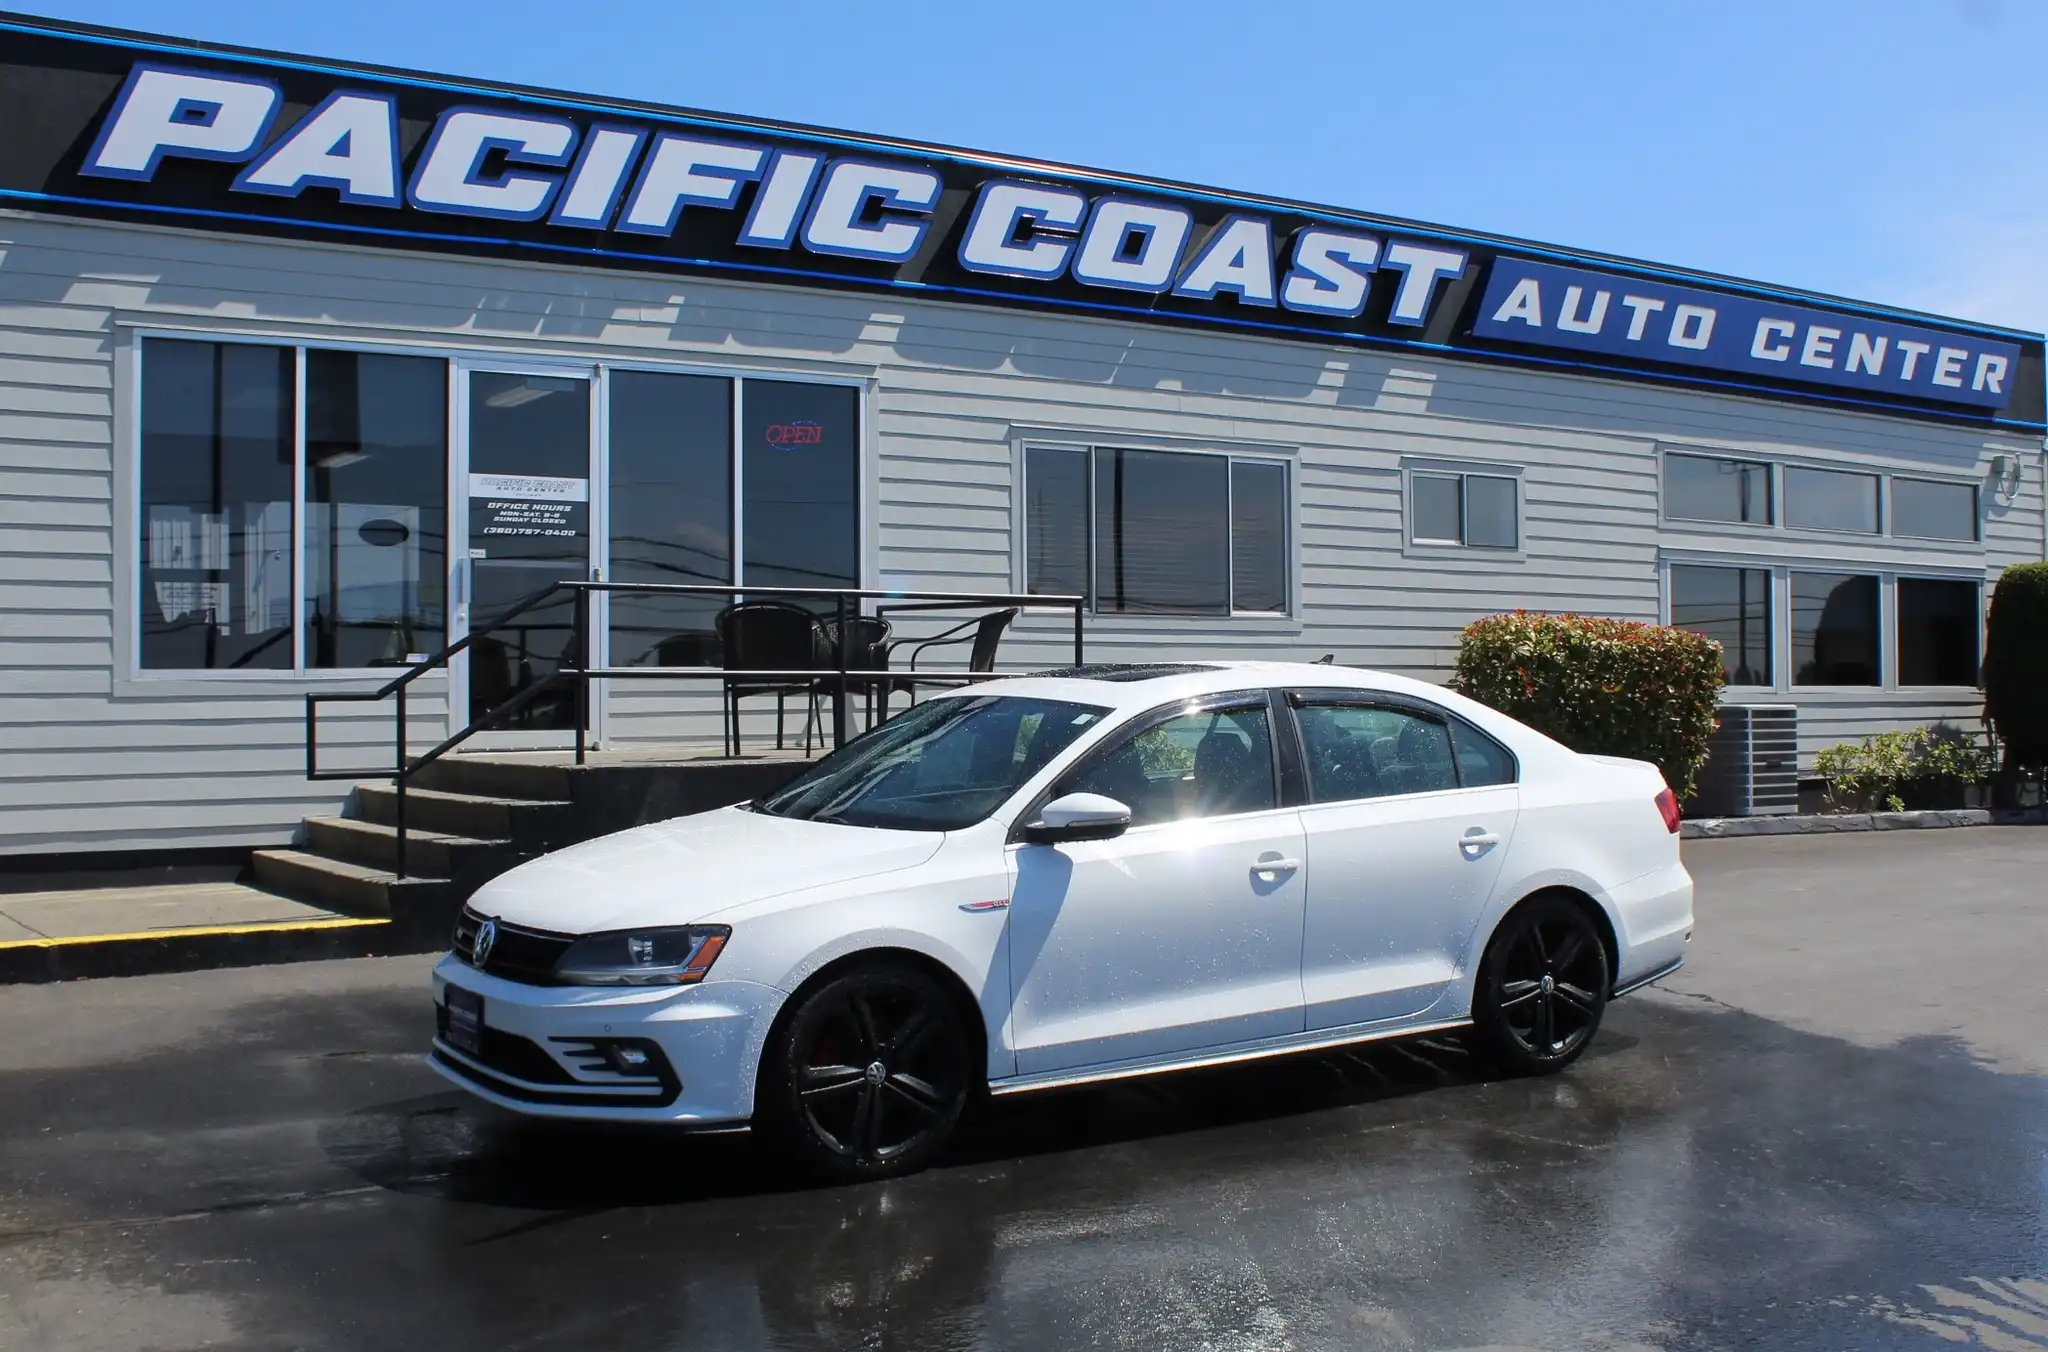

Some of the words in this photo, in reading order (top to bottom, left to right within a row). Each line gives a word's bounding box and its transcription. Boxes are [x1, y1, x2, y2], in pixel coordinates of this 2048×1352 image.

[80, 62, 942, 263] PACIFIC
[957, 179, 1468, 326] COAST
[1493, 279, 1717, 350] AUTO
[1750, 318, 2008, 394] CENTER
[766, 425, 822, 443] OPEN
[480, 478, 531, 487] PACIFIC
[532, 480, 576, 489] COAST
[532, 504, 572, 512] HOURS
